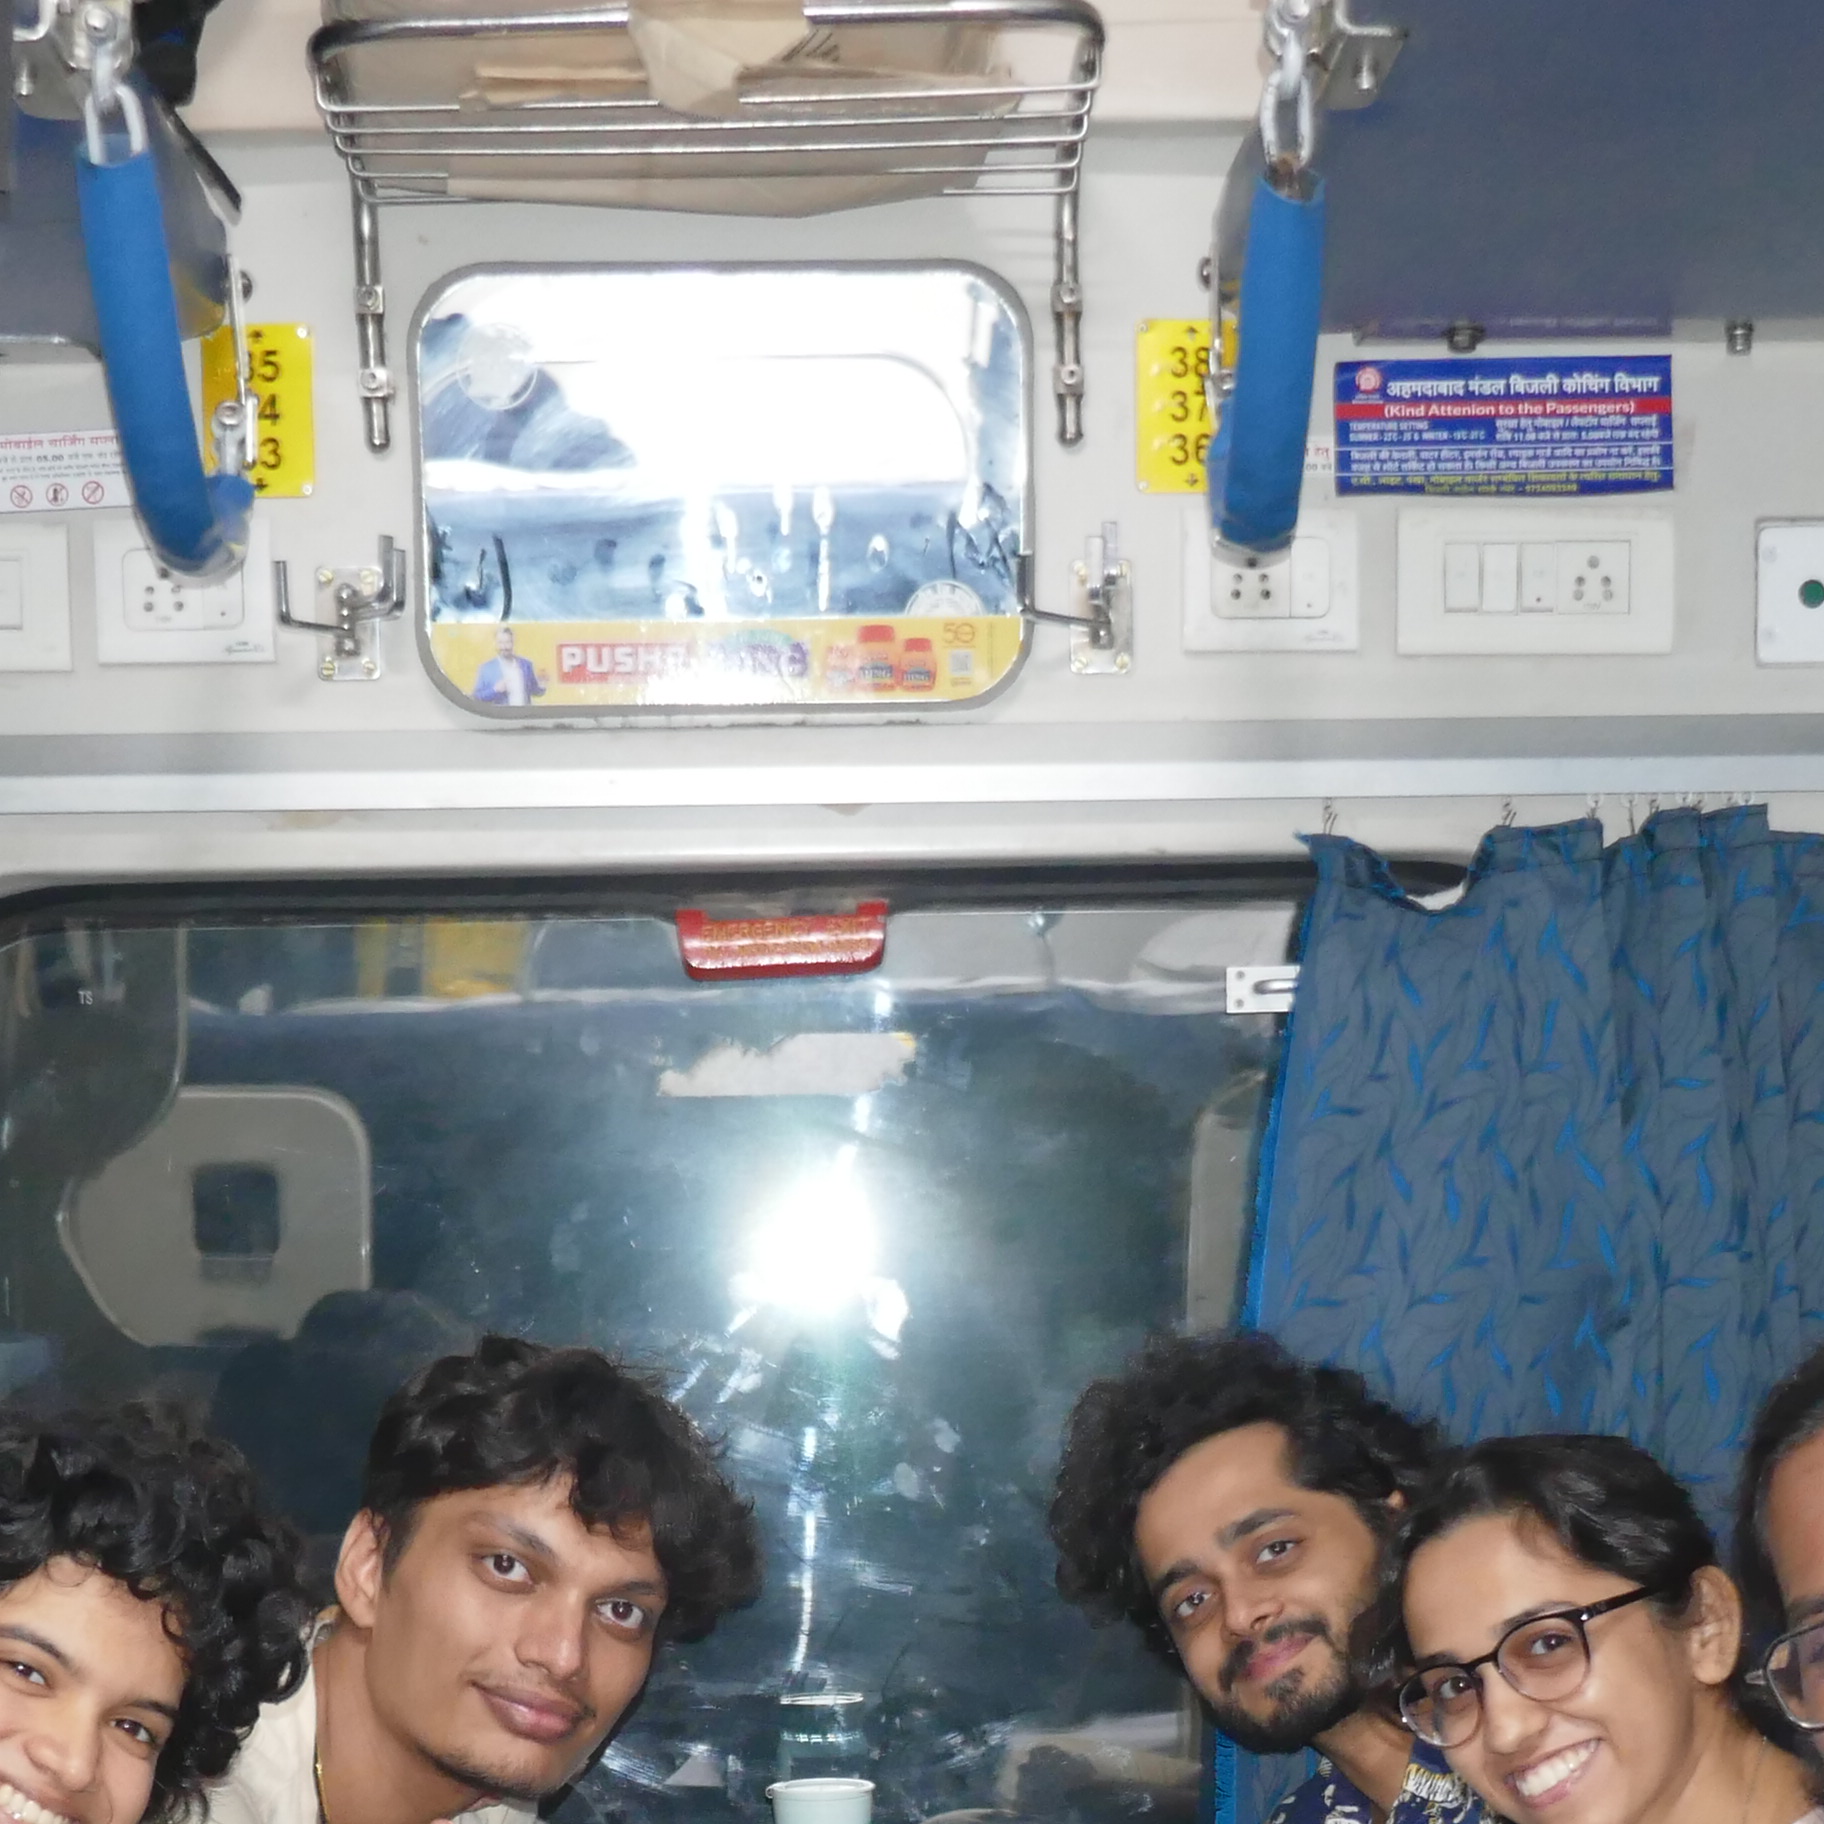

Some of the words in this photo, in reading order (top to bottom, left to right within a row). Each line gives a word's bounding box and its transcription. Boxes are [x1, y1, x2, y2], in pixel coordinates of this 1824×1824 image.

[1170, 345, 1210, 379] 38
[1387, 379, 1465, 398] अहमदाबाद
[1468, 375, 1505, 396] मंडल
[1510, 374, 1559, 395] बिजली
[1614, 373, 1660, 393] विभाग
[1384, 405, 1424, 418] (Kind
[1499, 403, 1515, 415] to
[1518, 402, 1543, 415] the
[1546, 401, 1635, 416] Passengers)
[1170, 432, 1211, 466] 36
